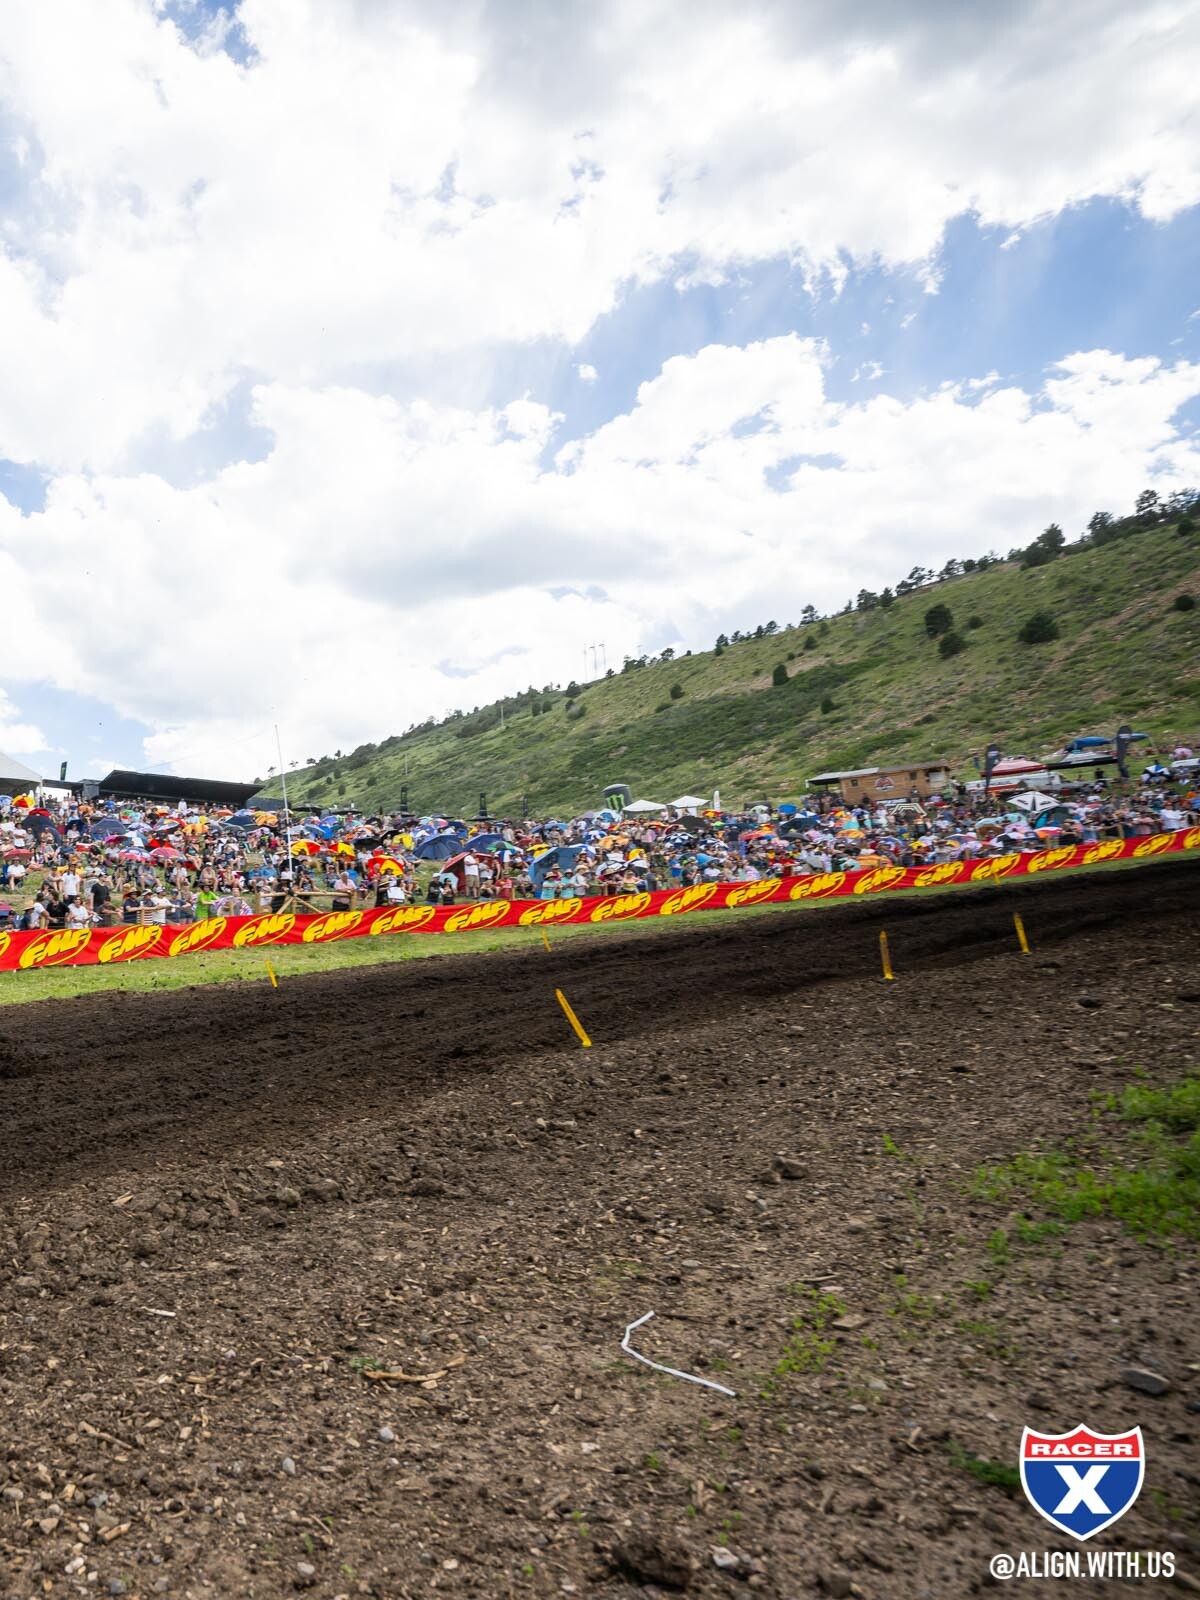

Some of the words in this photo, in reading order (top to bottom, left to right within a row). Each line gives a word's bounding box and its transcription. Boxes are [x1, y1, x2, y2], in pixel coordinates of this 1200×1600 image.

[727, 878, 782, 907] FMF
[790, 872, 844, 900] FMF
[853, 867, 904, 894] FMF
[520, 898, 581, 926] FMF
[592, 892, 650, 922] FMF
[661, 883, 717, 915] FMF
[236, 914, 294, 946] FMF
[303, 911, 362, 942] FMF
[372, 906, 434, 935] FMF
[448, 901, 509, 932] FMF
[23, 928, 89, 968] FMF
[100, 925, 161, 962] FMF
[170, 917, 226, 956] FMF
